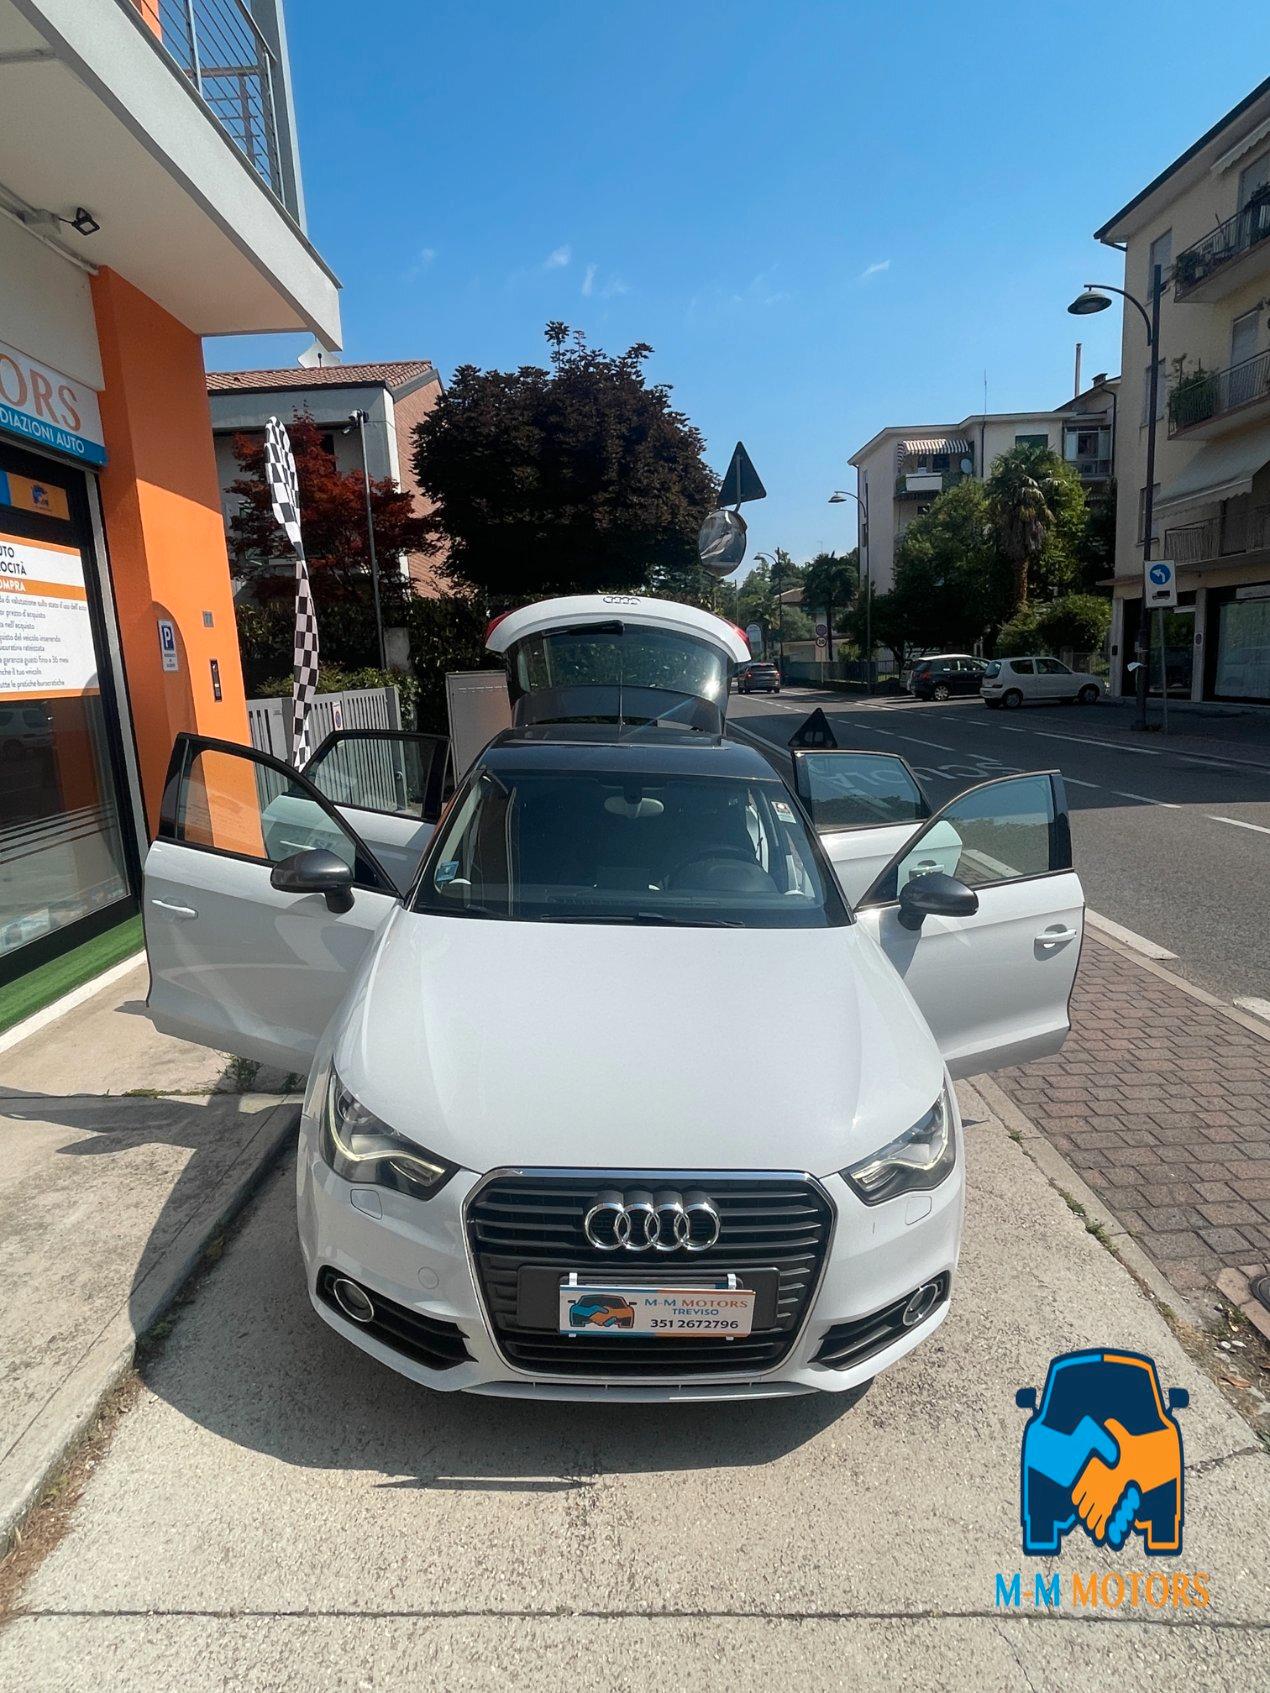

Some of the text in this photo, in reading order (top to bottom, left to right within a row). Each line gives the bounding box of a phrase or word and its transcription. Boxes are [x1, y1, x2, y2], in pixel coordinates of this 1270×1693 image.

[57, 433, 85, 454] AUTO
[0, 561, 27, 575] OCITÀ
[163, 627, 171, 648] P
[644, 1298, 749, 1308] M-M MOTORS
[672, 1308, 719, 1316] TREVISO
[650, 1319, 739, 1329] 351 2672796
